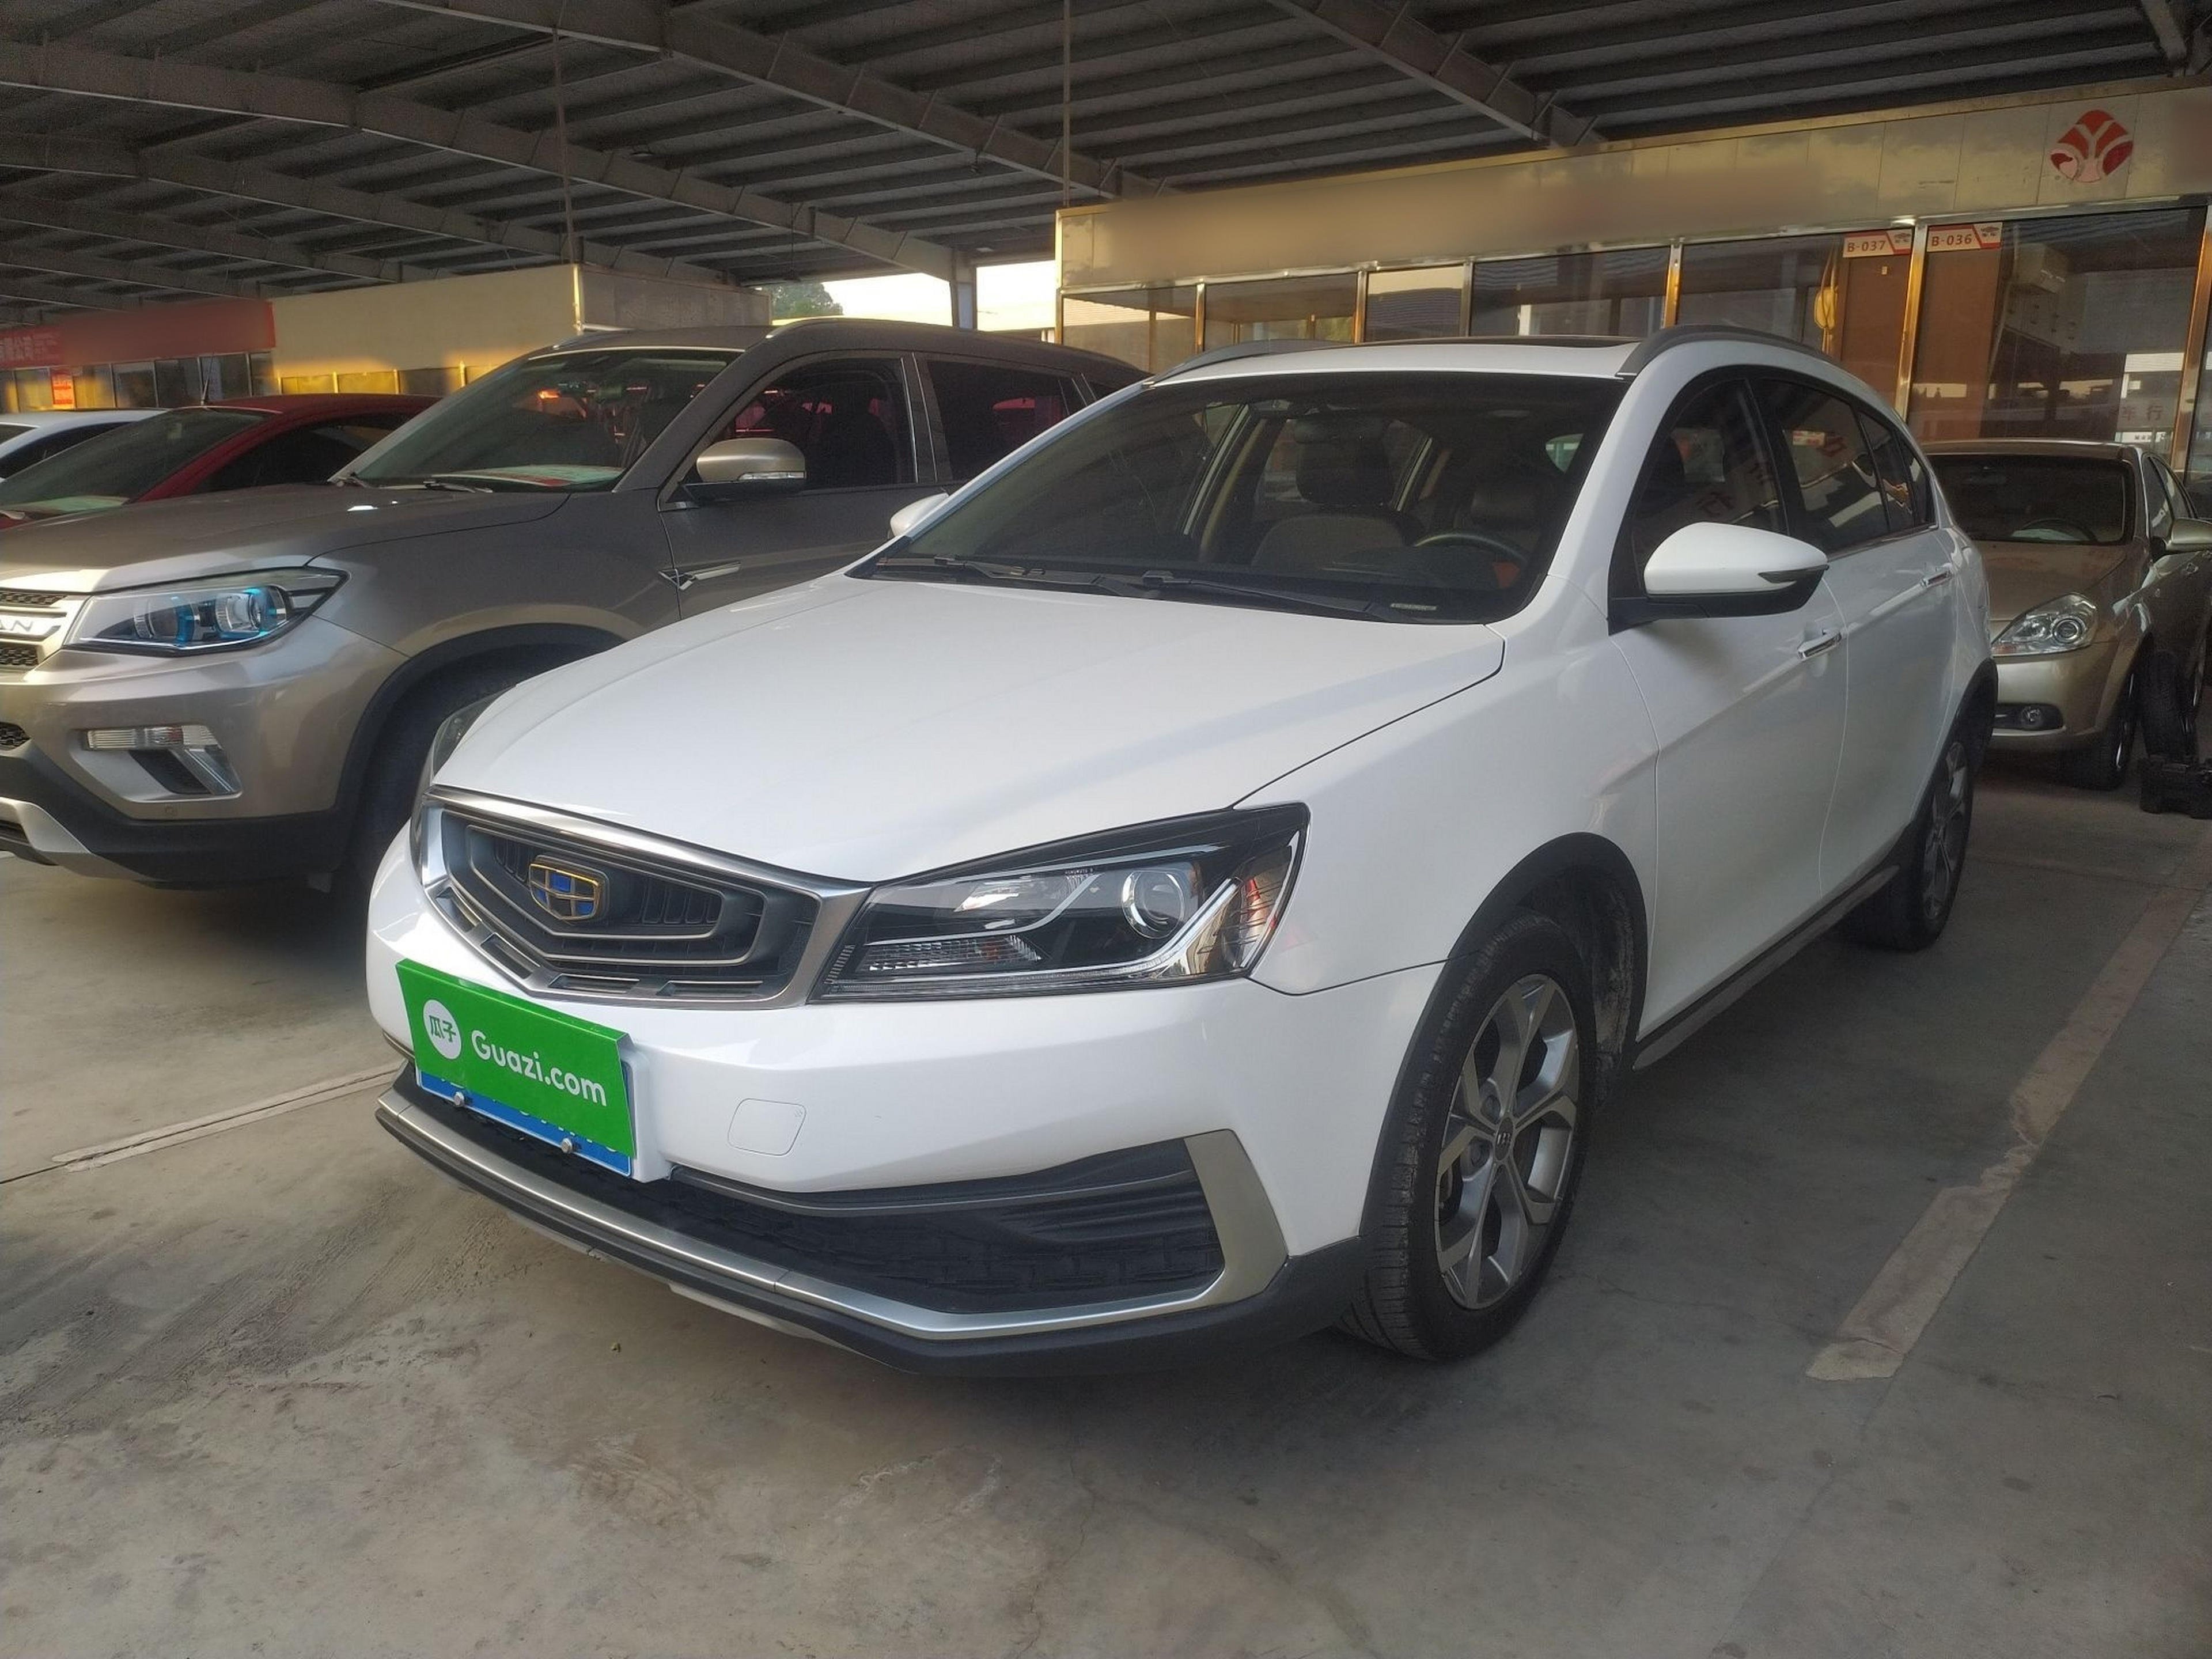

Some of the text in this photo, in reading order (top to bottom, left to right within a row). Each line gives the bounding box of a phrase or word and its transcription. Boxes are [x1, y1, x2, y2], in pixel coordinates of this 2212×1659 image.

[1847, 240, 1887, 252] B-037
[1931, 234, 1972, 247] B-036
[429, 1015, 457, 1043] 瓜子
[471, 1029, 607, 1107] Guazi.com
